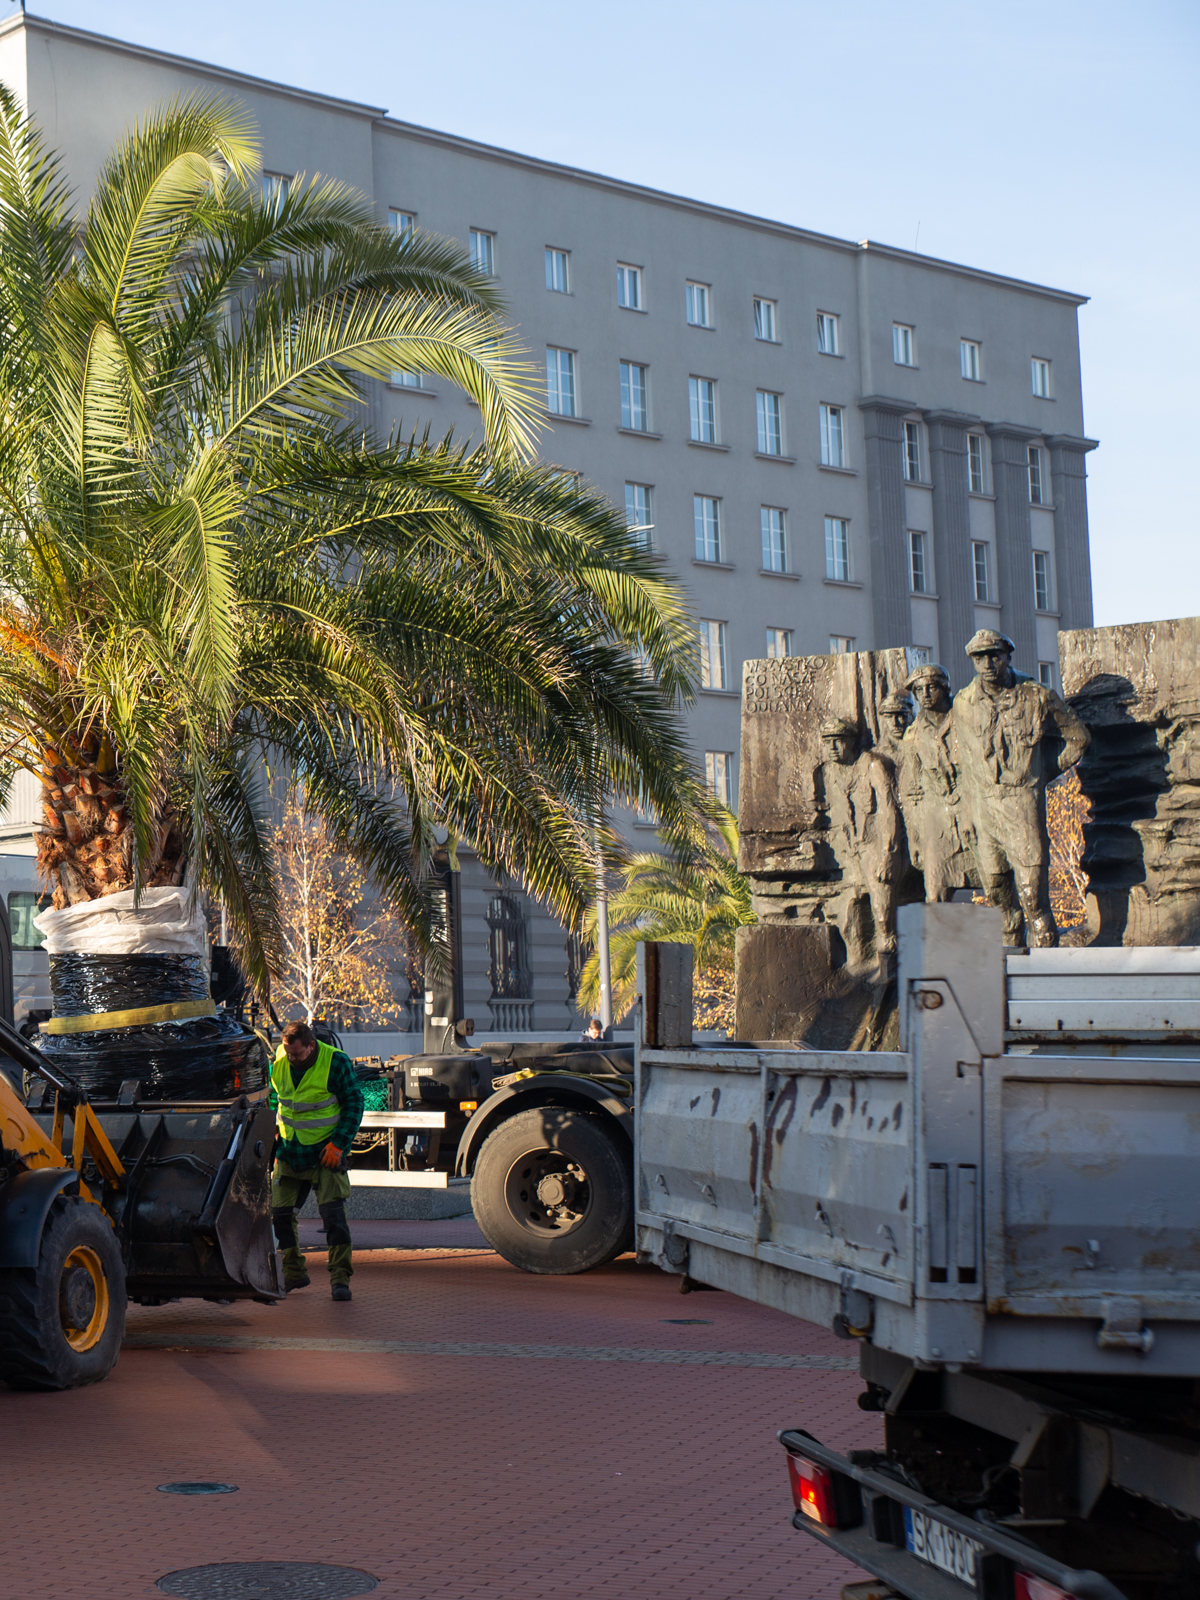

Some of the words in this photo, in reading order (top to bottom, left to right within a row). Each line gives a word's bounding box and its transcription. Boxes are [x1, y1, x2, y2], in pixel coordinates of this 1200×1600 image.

[746, 657, 824, 673] WSZYSTKO
[745, 674, 767, 686] CO
[772, 671, 816, 686] NASZE
[419, 1067, 433, 1076] HIAB
[914, 1511, 936, 1560] SK
